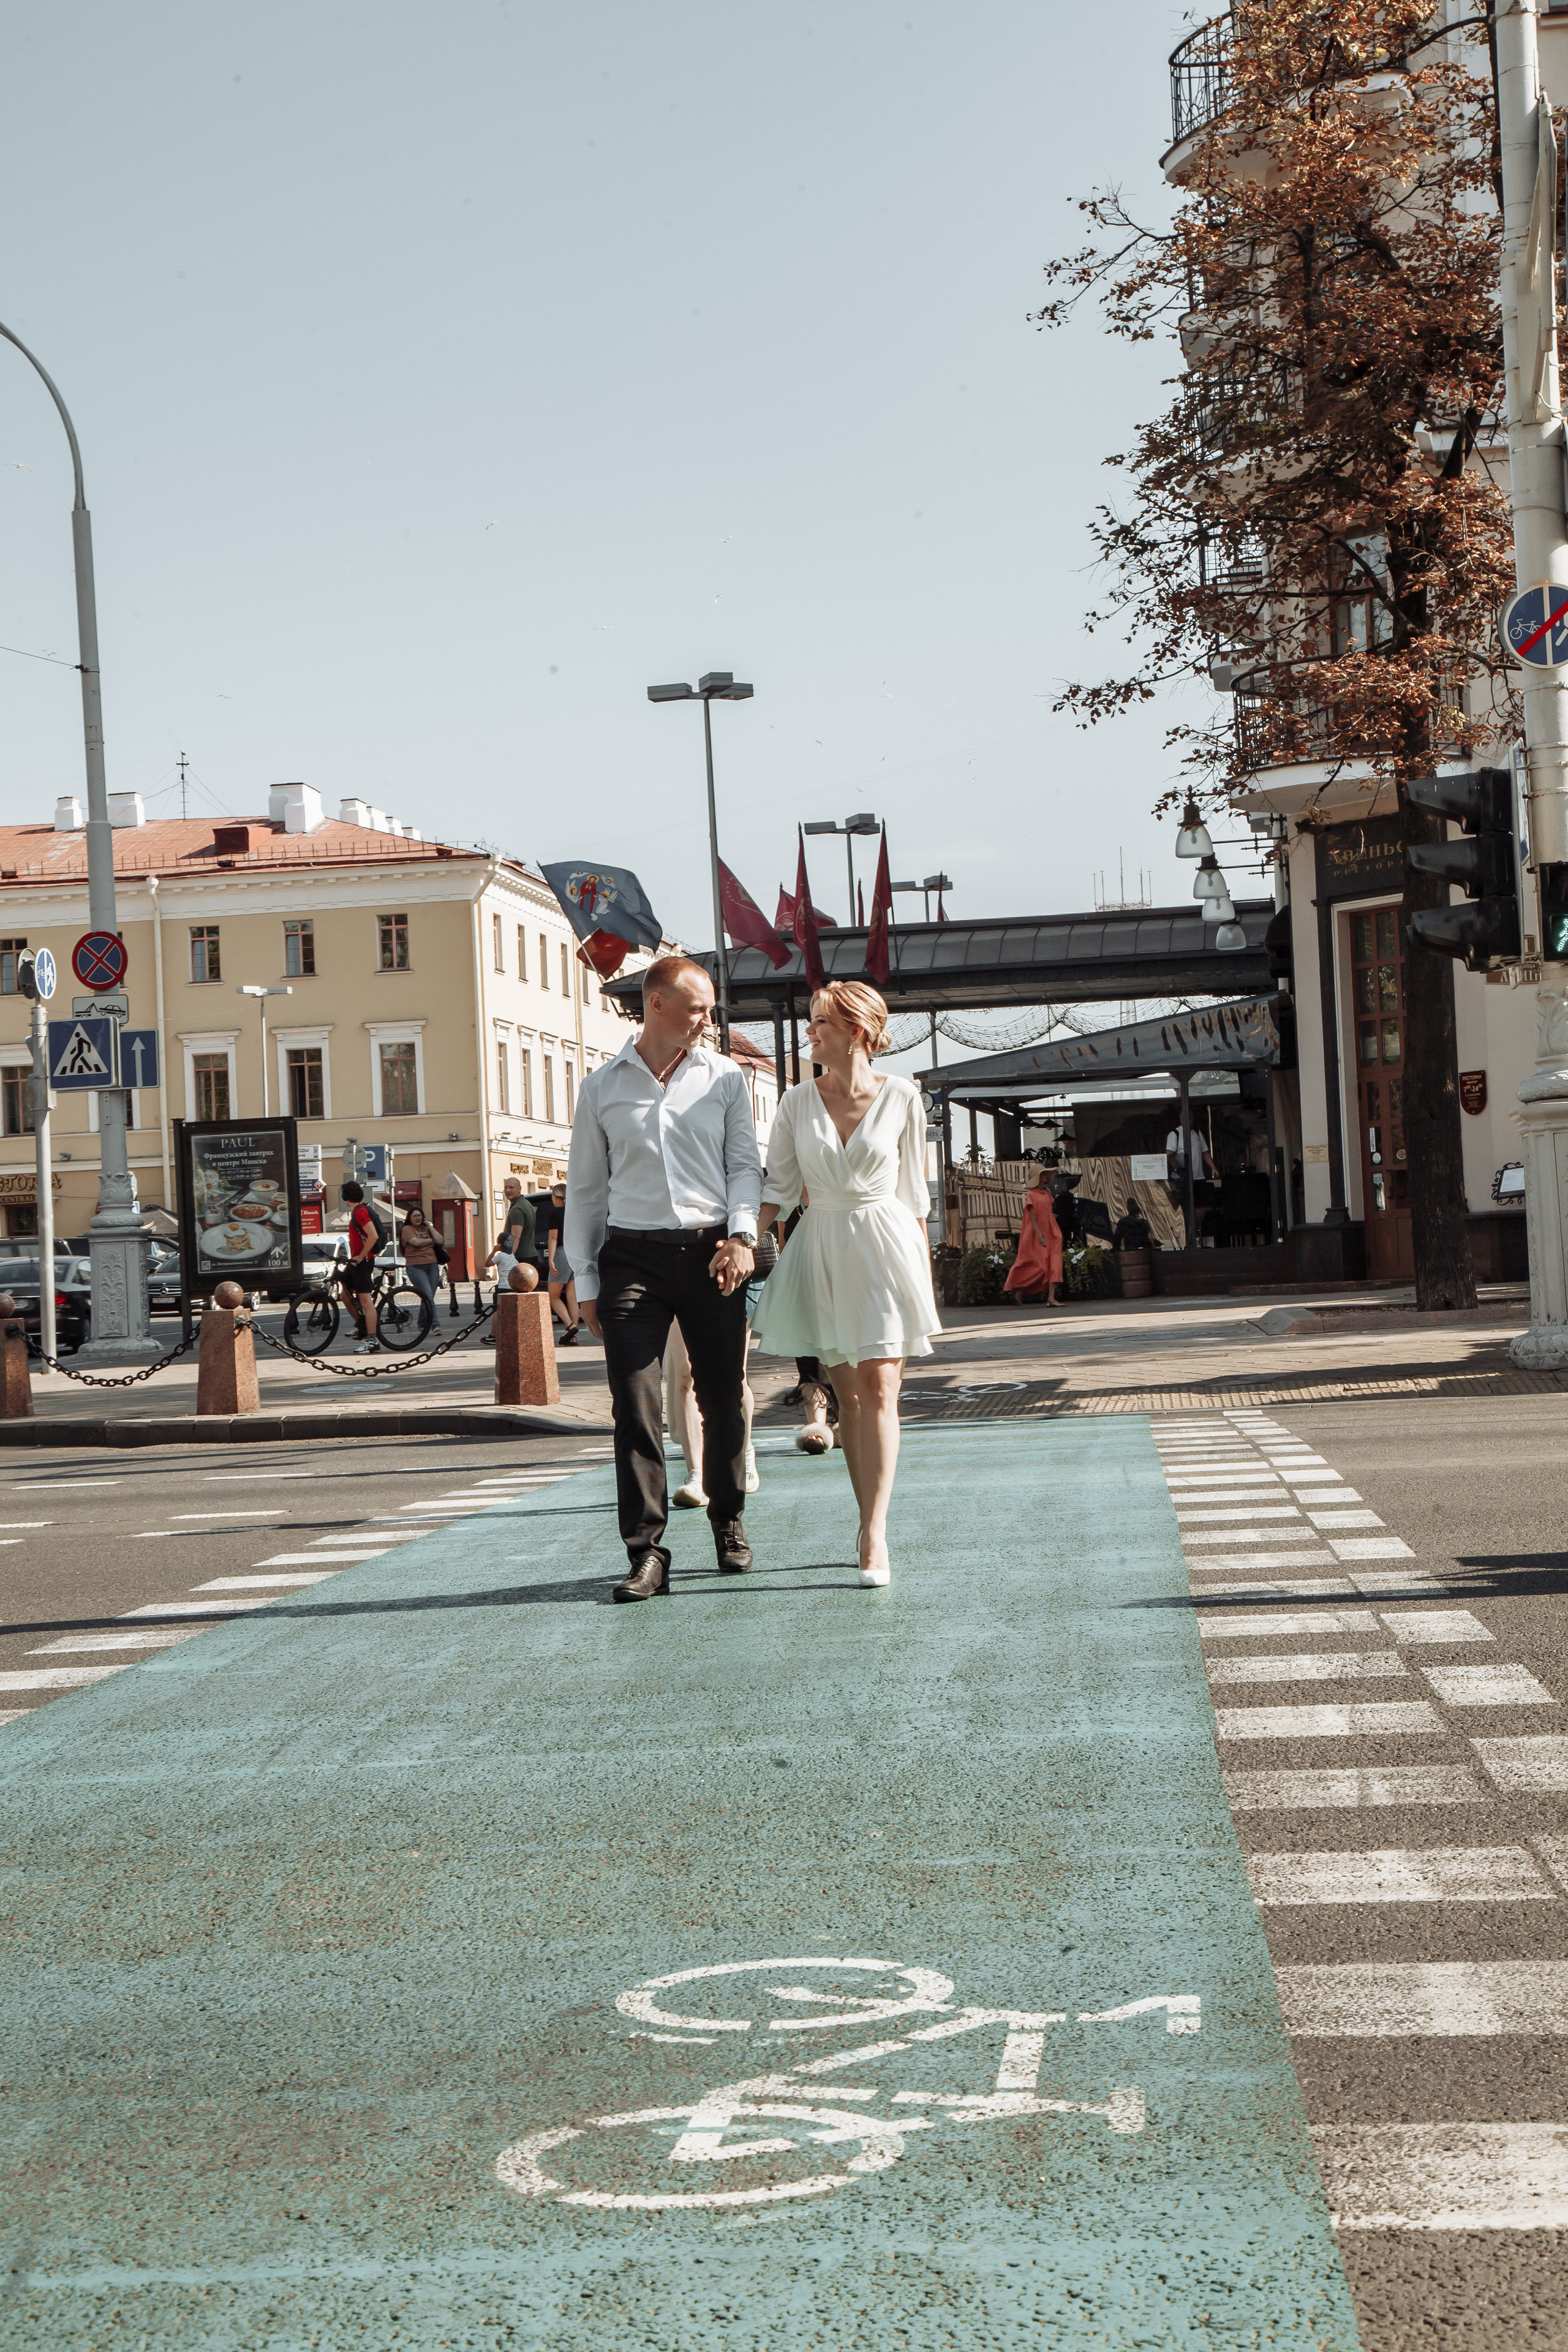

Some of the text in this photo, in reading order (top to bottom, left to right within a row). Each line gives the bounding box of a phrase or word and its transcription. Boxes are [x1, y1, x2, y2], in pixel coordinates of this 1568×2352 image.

[221, 1137, 255, 1148] PAUL
[203, 1151, 247, 1161] Французский
[363, 1151, 375, 1168] P
[0, 1174, 62, 1193] STORA
